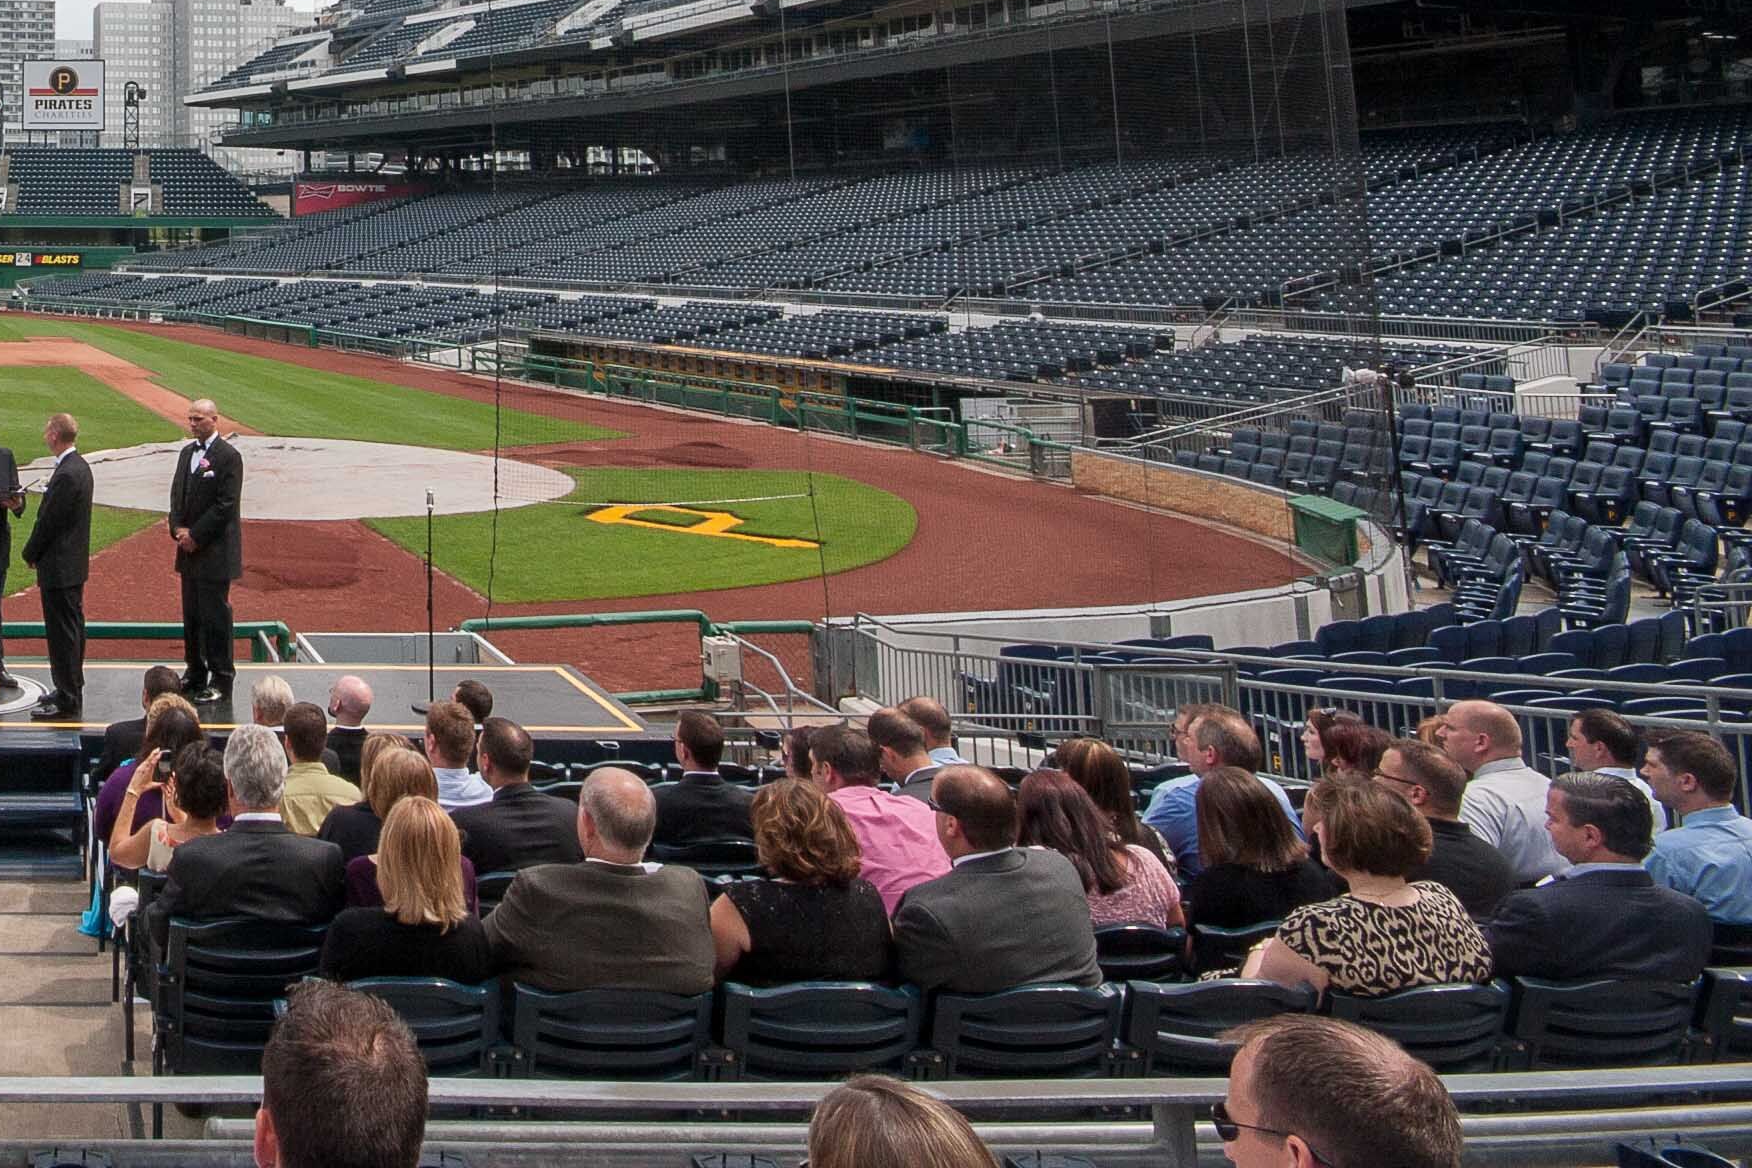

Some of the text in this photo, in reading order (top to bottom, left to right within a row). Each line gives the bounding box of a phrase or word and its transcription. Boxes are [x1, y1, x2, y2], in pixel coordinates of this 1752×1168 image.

[58, 73, 71, 90] P
[35, 99, 93, 110] PIRATES
[34, 112, 93, 120] CHARITIES
[337, 184, 387, 193] BOWTIE
[41, 255, 80, 264] BLASTS
